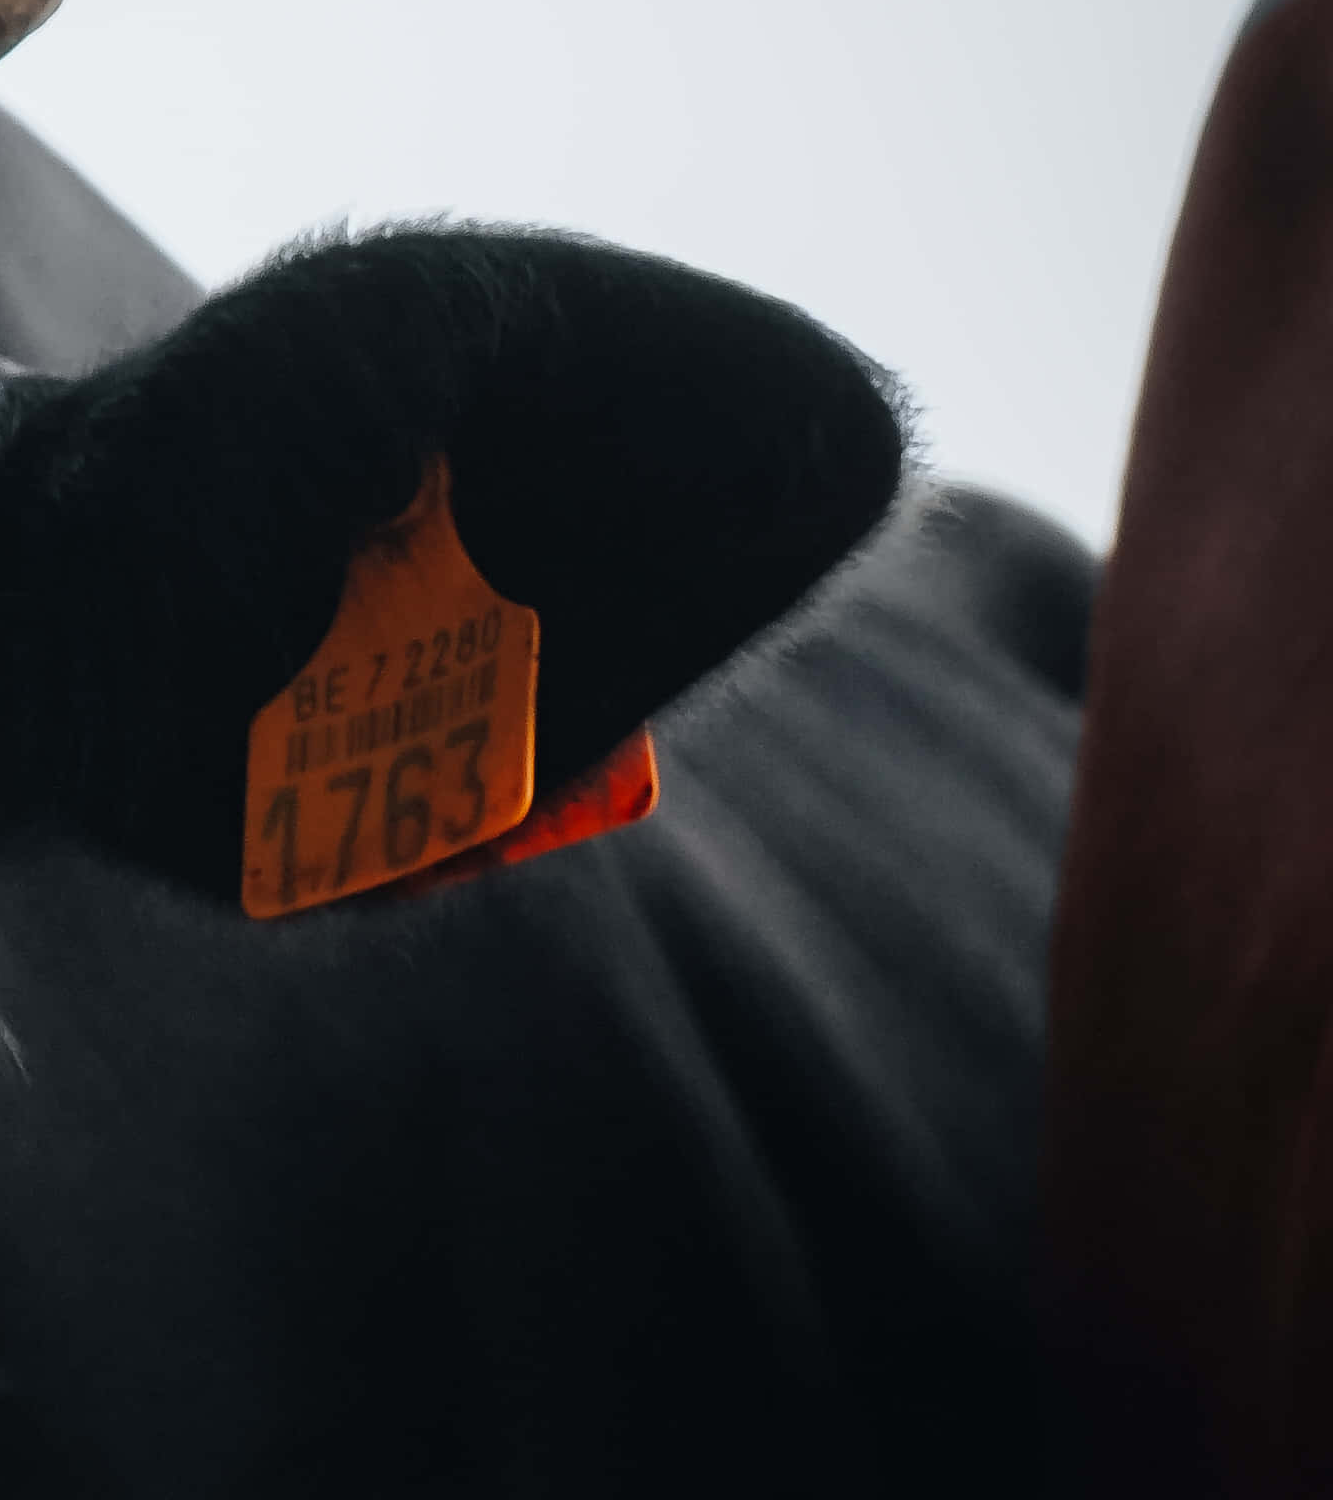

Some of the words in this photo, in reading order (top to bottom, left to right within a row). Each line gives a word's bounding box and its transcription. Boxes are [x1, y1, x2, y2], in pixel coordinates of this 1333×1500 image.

[293, 664, 350, 722] BE
[364, 650, 388, 702] 7
[260, 716, 491, 905] 1763
